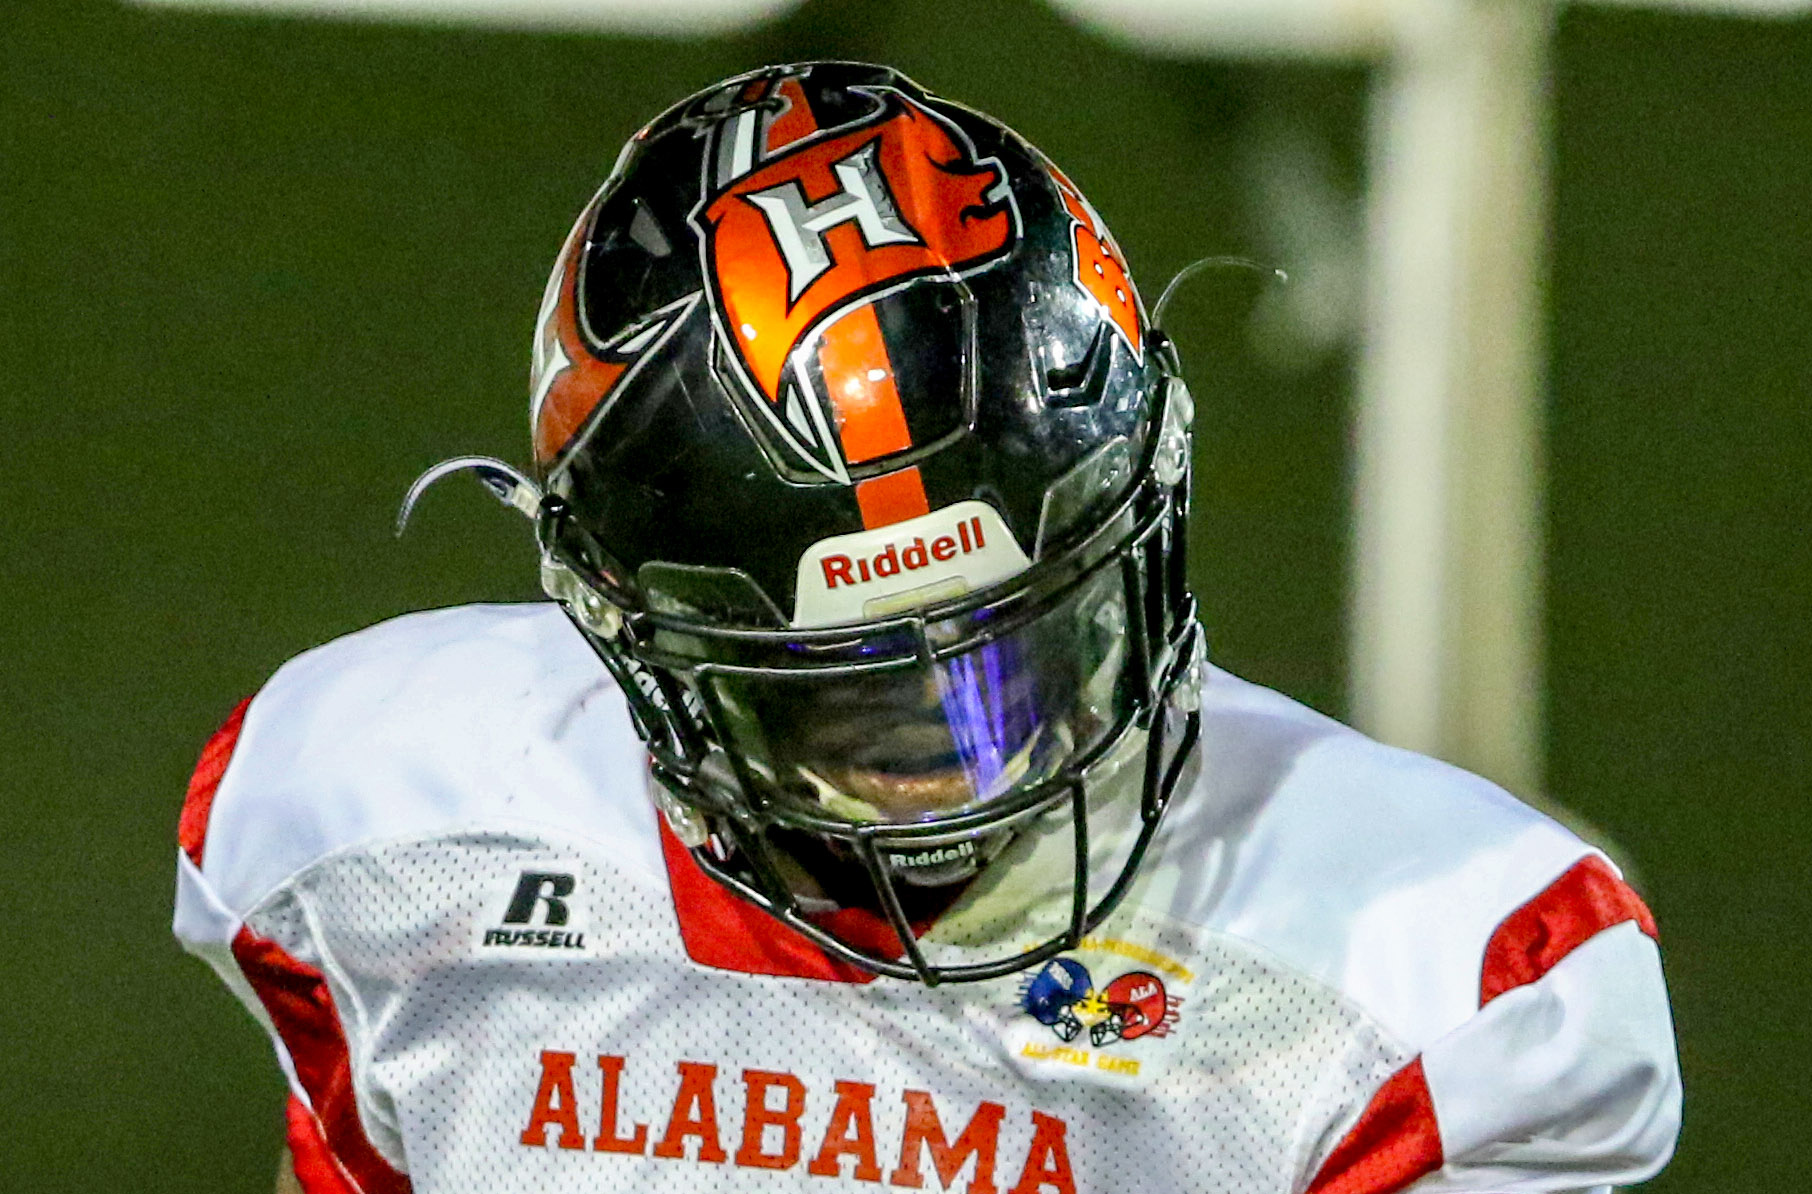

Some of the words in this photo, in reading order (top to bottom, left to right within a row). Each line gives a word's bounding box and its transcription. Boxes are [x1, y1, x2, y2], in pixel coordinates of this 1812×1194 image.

[746, 141, 919, 303] H
[820, 516, 986, 590] Riddell
[889, 841, 975, 867] Riddell
[502, 869, 577, 927] R
[482, 929, 586, 950] RUSSELL
